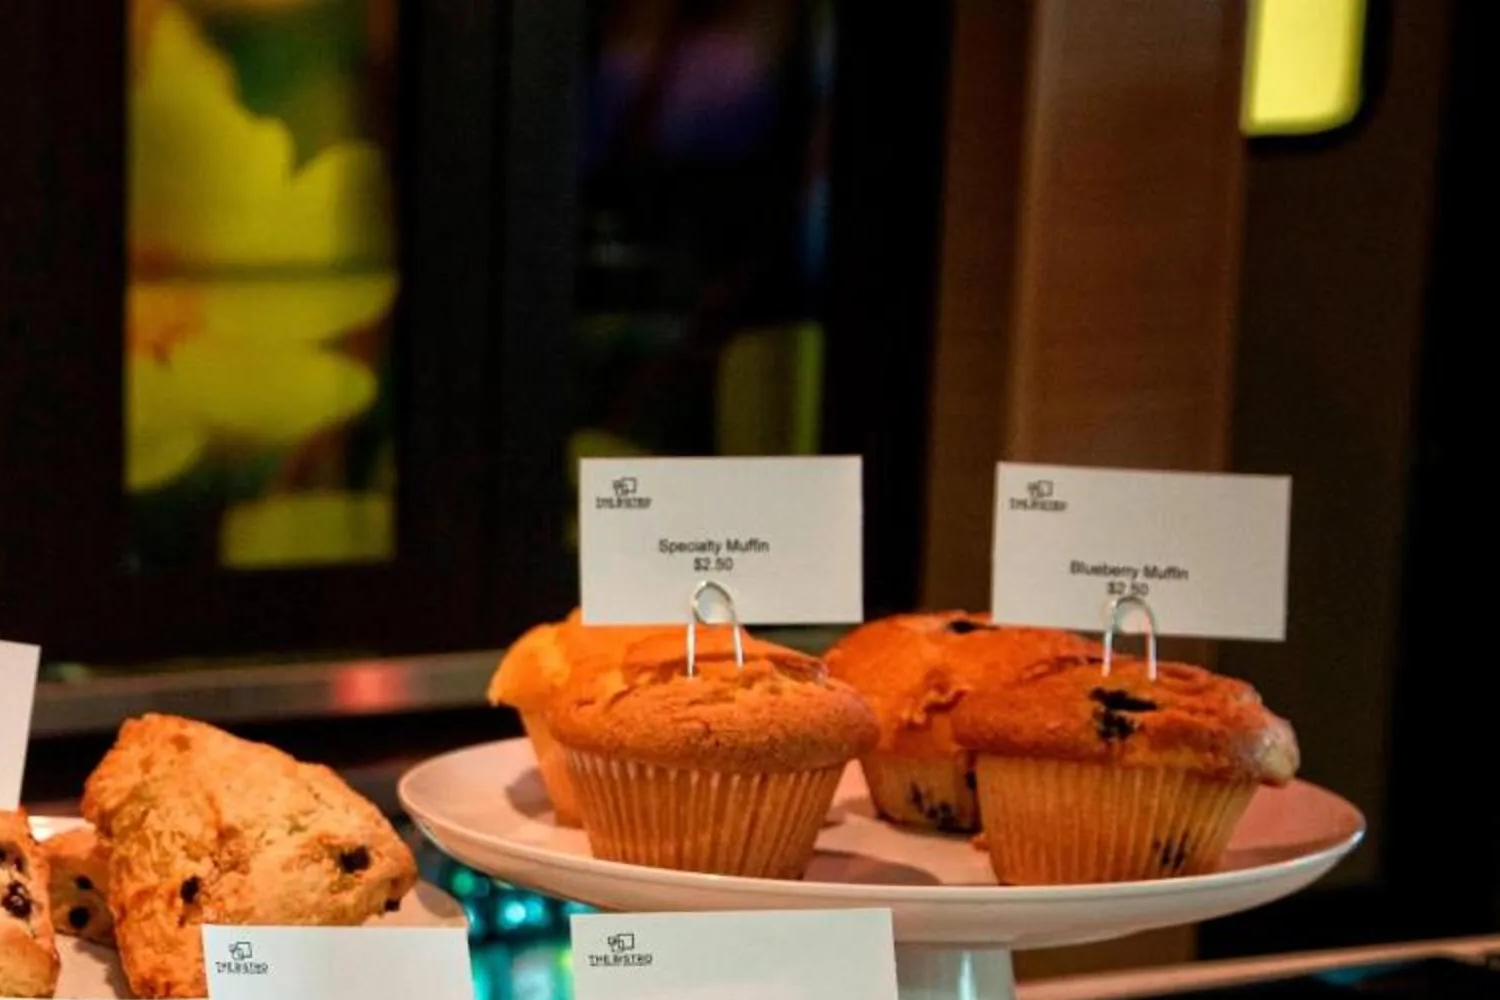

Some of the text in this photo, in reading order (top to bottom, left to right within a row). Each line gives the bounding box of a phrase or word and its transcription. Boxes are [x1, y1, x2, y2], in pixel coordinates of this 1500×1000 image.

[659, 538, 769, 555] Specialty Muffin
[1070, 560, 1188, 581] Blueberry Muffin
